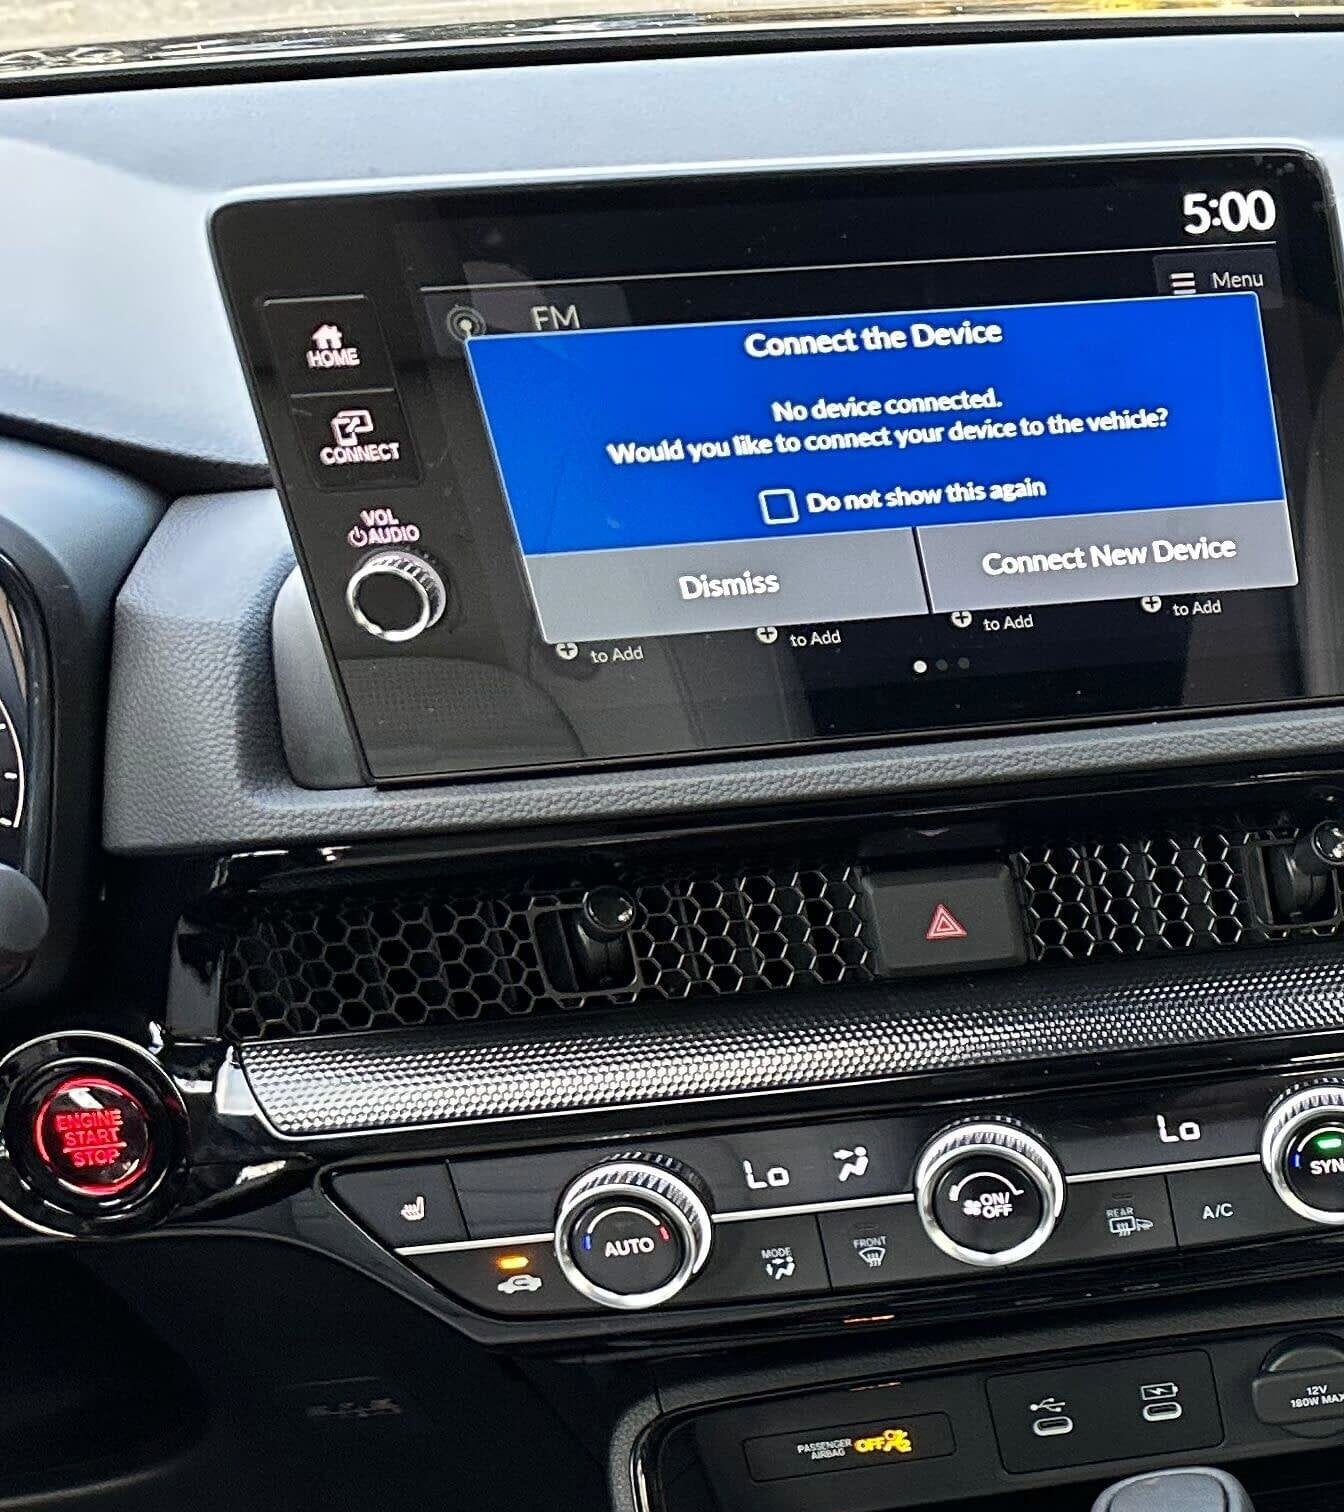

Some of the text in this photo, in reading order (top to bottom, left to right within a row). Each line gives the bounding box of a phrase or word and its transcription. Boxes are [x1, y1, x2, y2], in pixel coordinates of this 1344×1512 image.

[1183, 189, 1276, 235] 5:00
[1212, 272, 1264, 288] Menu
[530, 304, 581, 331] FM
[744, 320, 1003, 358] Connect the Device
[306, 348, 361, 369] HOME
[771, 387, 1003, 423] No device connected.
[606, 407, 1169, 465] Would you like to connect your device to the vehicle?
[320, 442, 400, 465] CONNECT
[805, 477, 1047, 514] Do not show this again
[360, 508, 400, 526] VOL
[367, 524, 420, 544] AUDIO
[981, 536, 1238, 577] Connect New Device
[678, 569, 780, 601] Dismiss
[1173, 600, 1222, 617] to Add
[983, 614, 1034, 631] to Add
[789, 630, 841, 648] to Add
[590, 645, 644, 664] to Add
[55, 1109, 124, 1132] ENGINE
[1156, 1114, 1201, 1143] Lo
[64, 1127, 120, 1146] START
[73, 1148, 120, 1167] STOP
[743, 1159, 790, 1190] Lo
[979, 1191, 1010, 1206] ON/
[982, 1203, 1013, 1219] OFF
[1106, 1206, 1134, 1218] REAR
[1202, 1203, 1234, 1220] A/C
[604, 1237, 655, 1258] AUTO
[853, 1235, 887, 1249] FRONT
[761, 1247, 792, 1260] MODE
[1306, 1385, 1328, 1396] 12V
[1290, 1397, 1320, 1409] 180W
[797, 1438, 853, 1454] PASSENGER
[811, 1447, 846, 1460] AIRBAG
[854, 1437, 885, 1453] OFF
